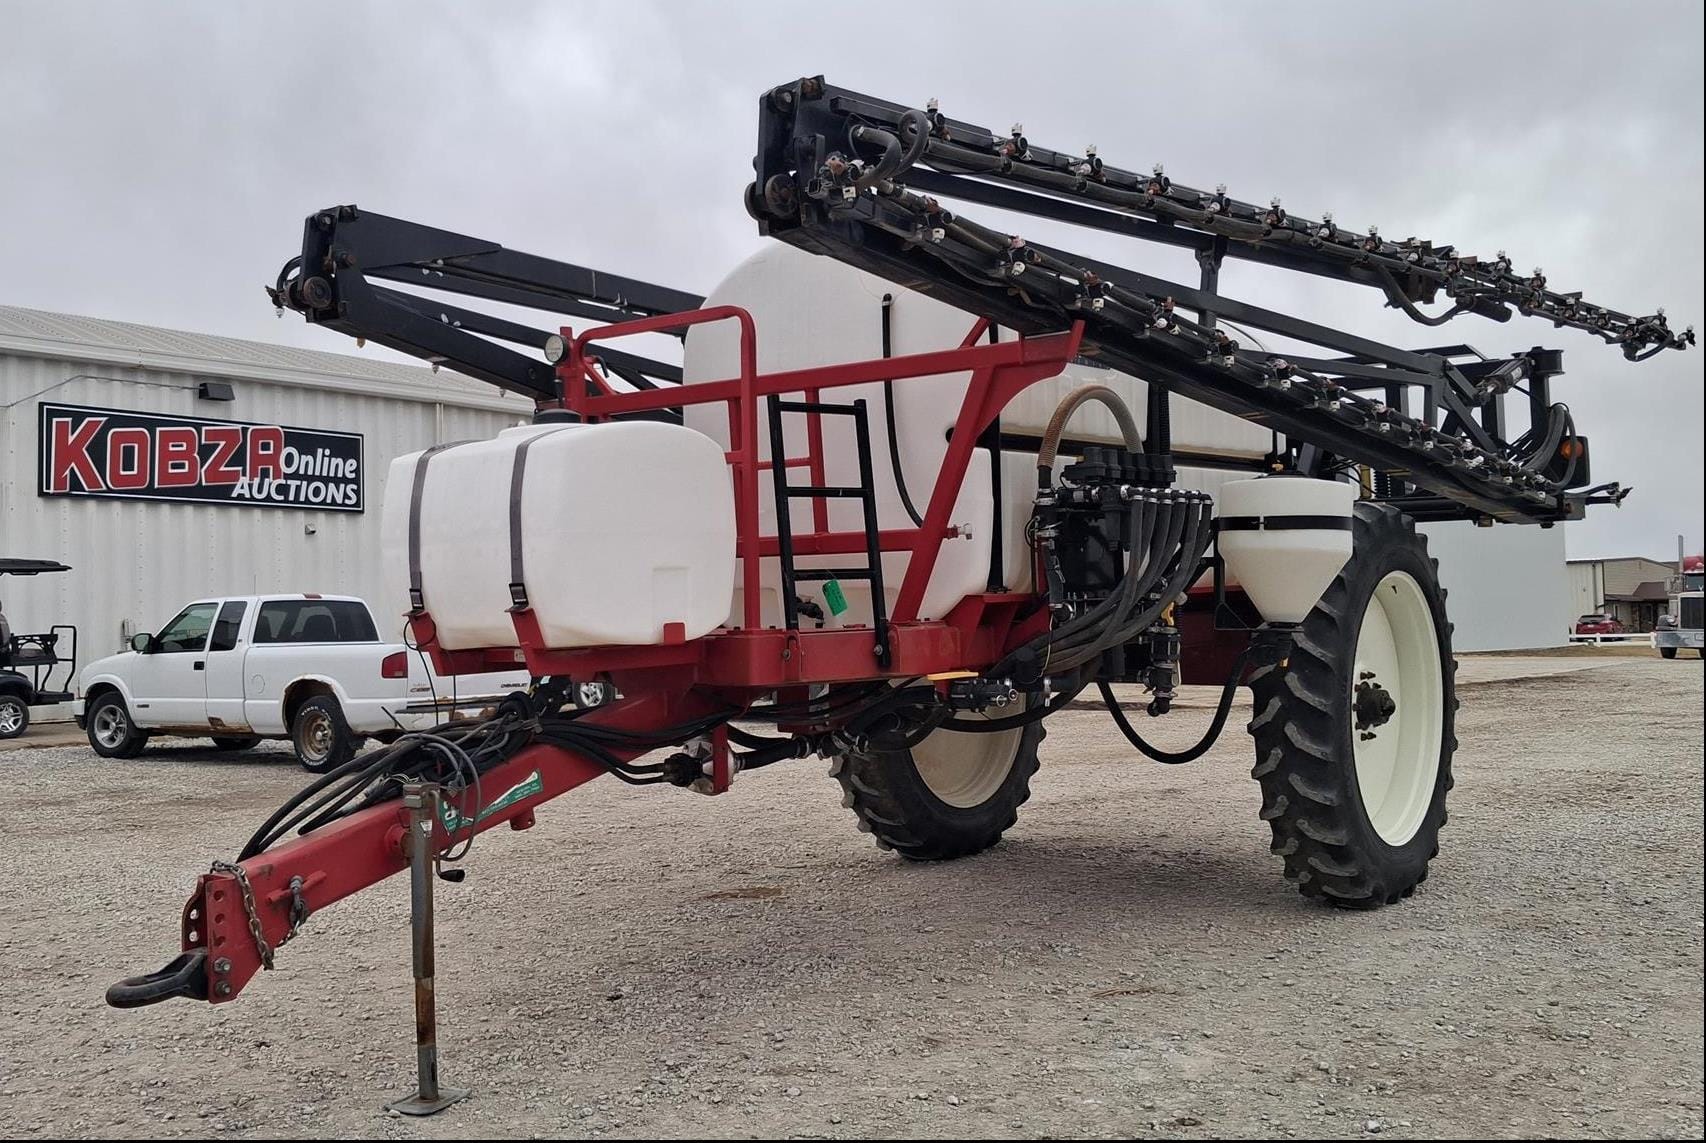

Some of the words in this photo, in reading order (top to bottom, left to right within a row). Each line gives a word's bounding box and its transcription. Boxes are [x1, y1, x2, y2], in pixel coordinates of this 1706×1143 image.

[51, 417, 285, 492] KOBZA
[279, 446, 358, 478] Online
[231, 476, 358, 505] AUCTIONS
